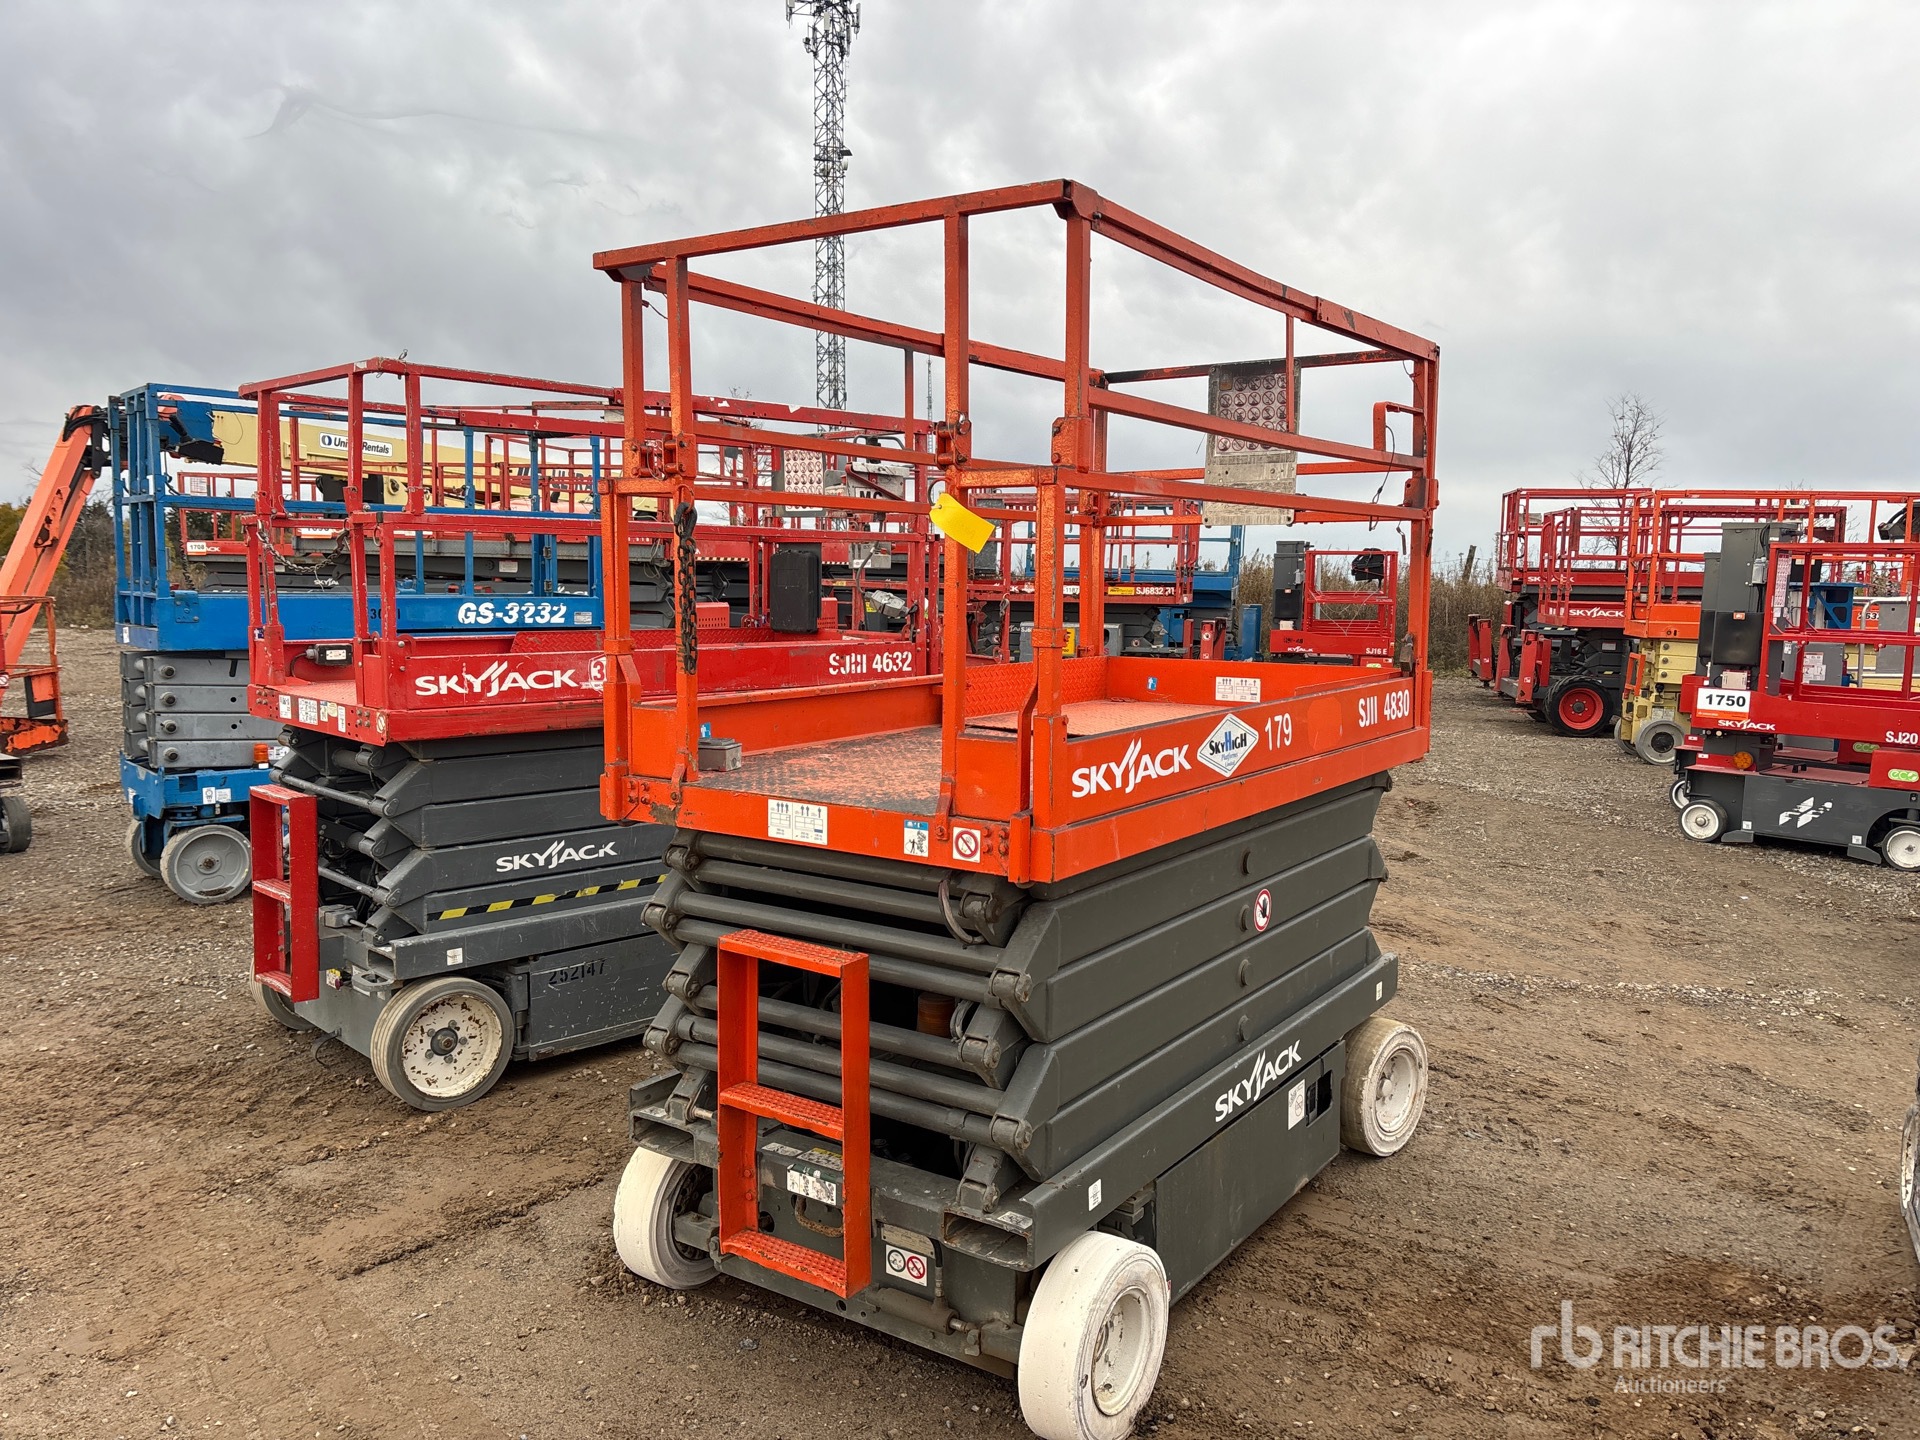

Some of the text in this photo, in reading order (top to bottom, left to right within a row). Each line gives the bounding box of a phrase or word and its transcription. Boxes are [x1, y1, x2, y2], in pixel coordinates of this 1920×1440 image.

[362, 442, 389, 454] Rentals
[1136, 586, 1164, 595] SJ6832
[457, 602, 567, 624] GS-3232
[1569, 607, 1625, 618] SKYJACK
[872, 651, 912, 673] 4632
[415, 660, 582, 697] SKYJACK
[1384, 689, 1410, 721] 4830
[1706, 694, 1746, 707] 1750
[1264, 713, 1292, 751] 179
[1717, 719, 1776, 731] SKYJACK
[1885, 731, 1919, 744] SJ20
[1072, 738, 1191, 798] SKYJACK
[496, 840, 618, 872] SKYJACK
[1215, 1040, 1301, 1122] SKYJACK
